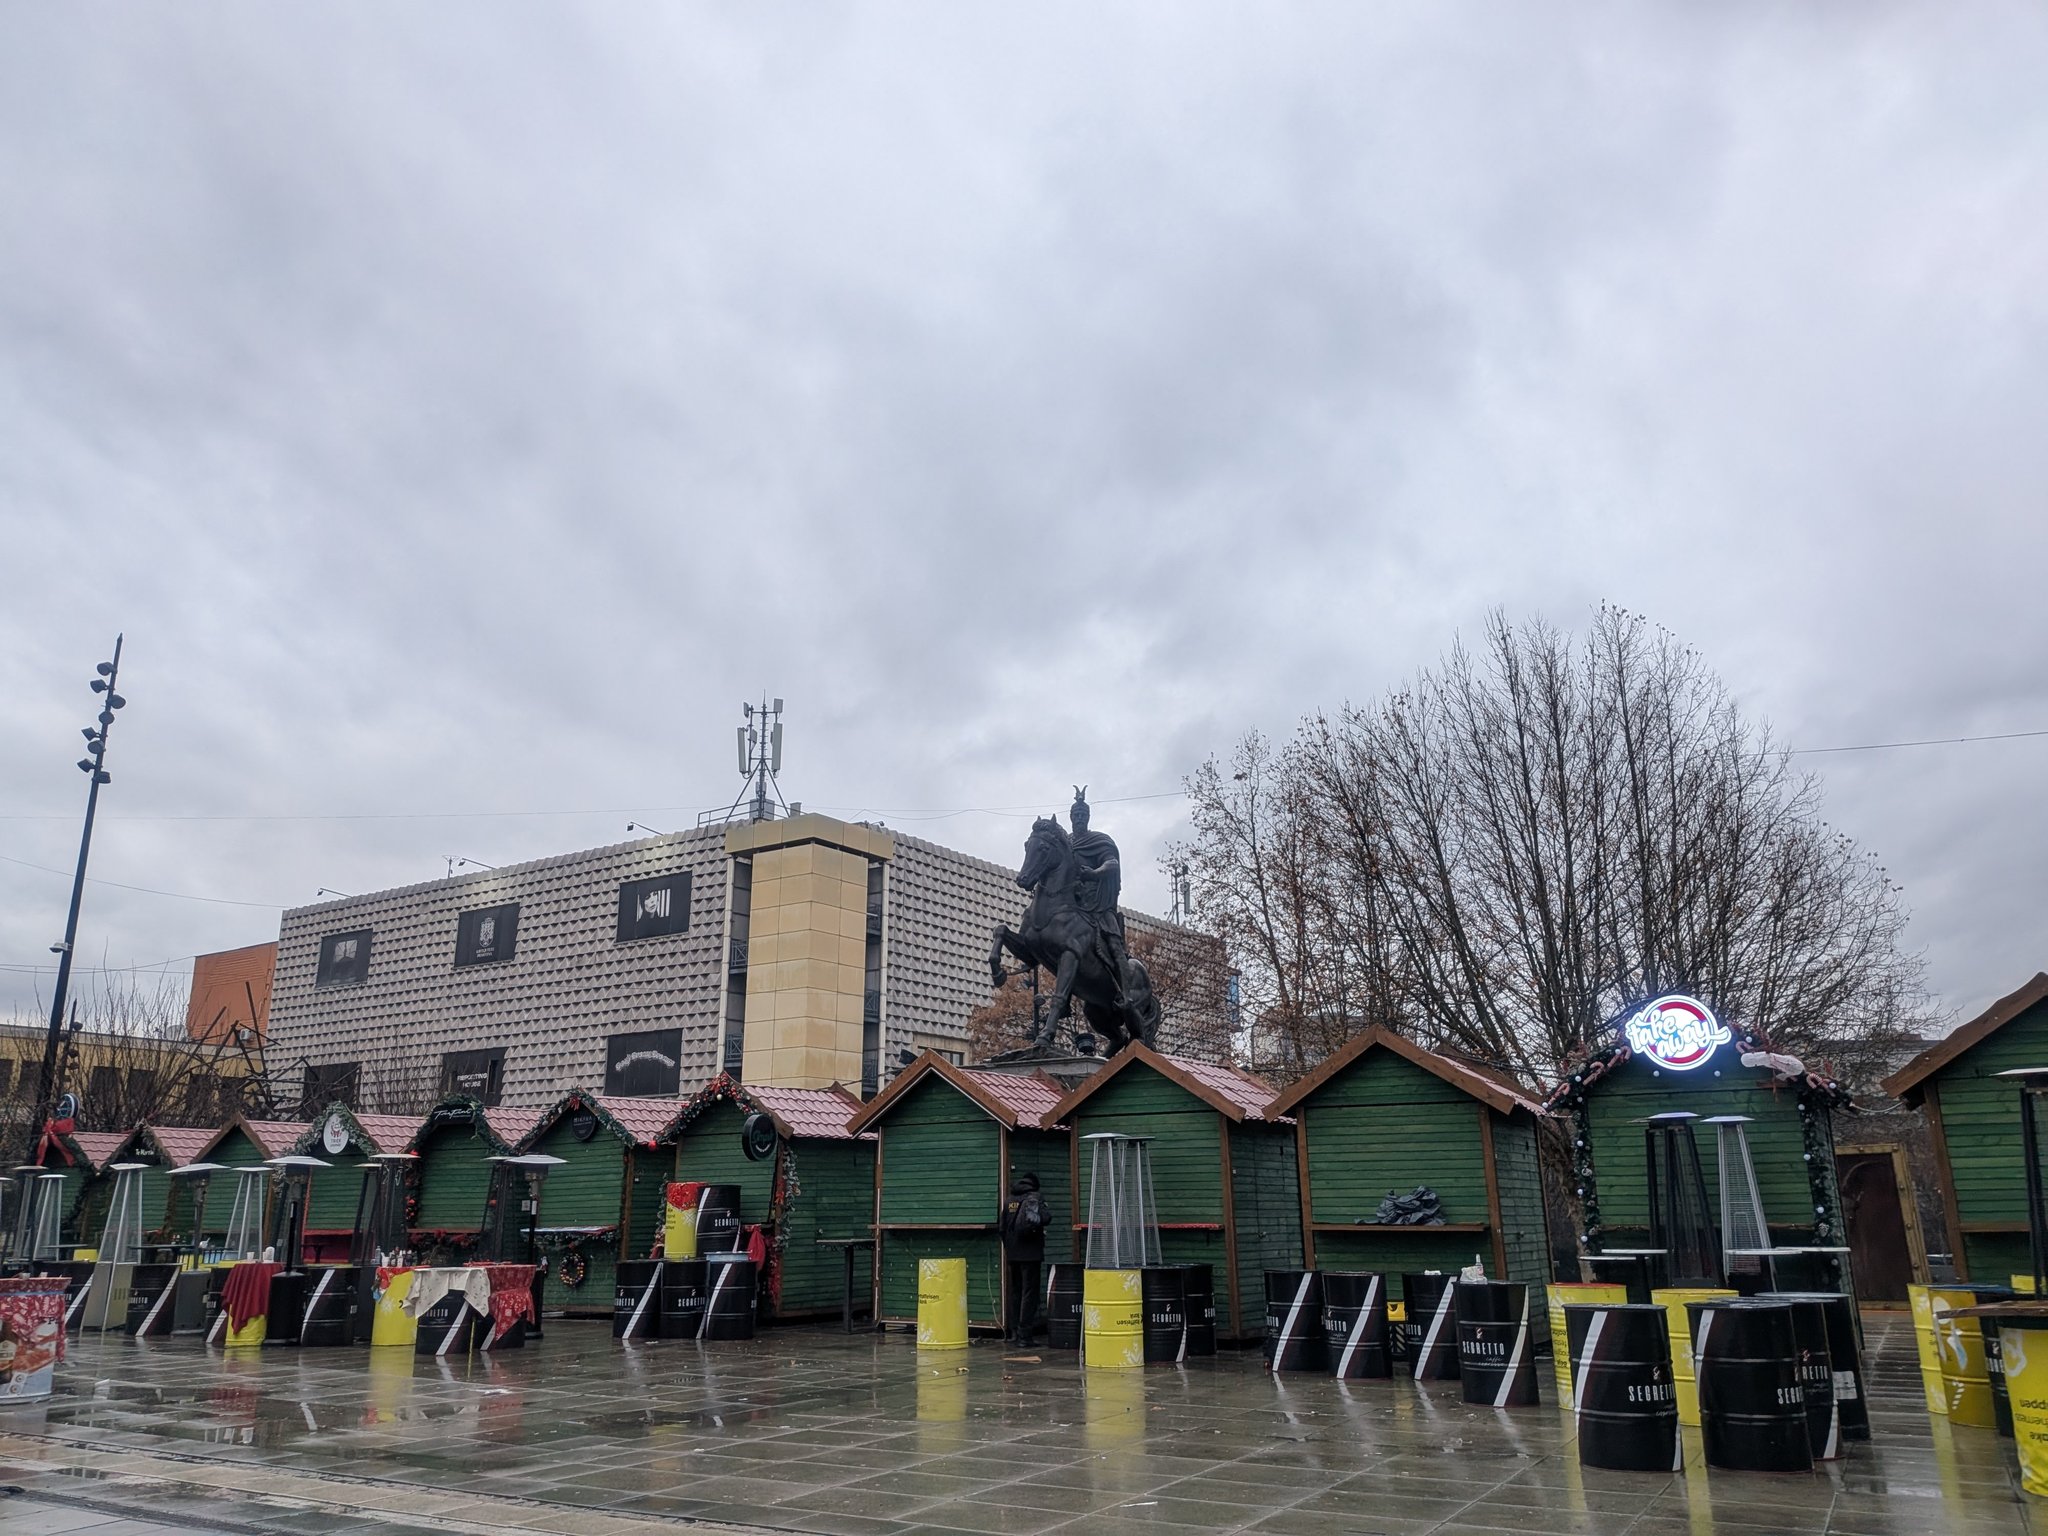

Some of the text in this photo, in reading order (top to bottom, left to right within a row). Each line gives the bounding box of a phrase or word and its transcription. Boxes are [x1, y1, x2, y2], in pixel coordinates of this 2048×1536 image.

[1628, 1009, 1676, 1051] take
[1657, 1020, 1730, 1058] away
[1462, 1340, 1506, 1356] SEGRETTO
